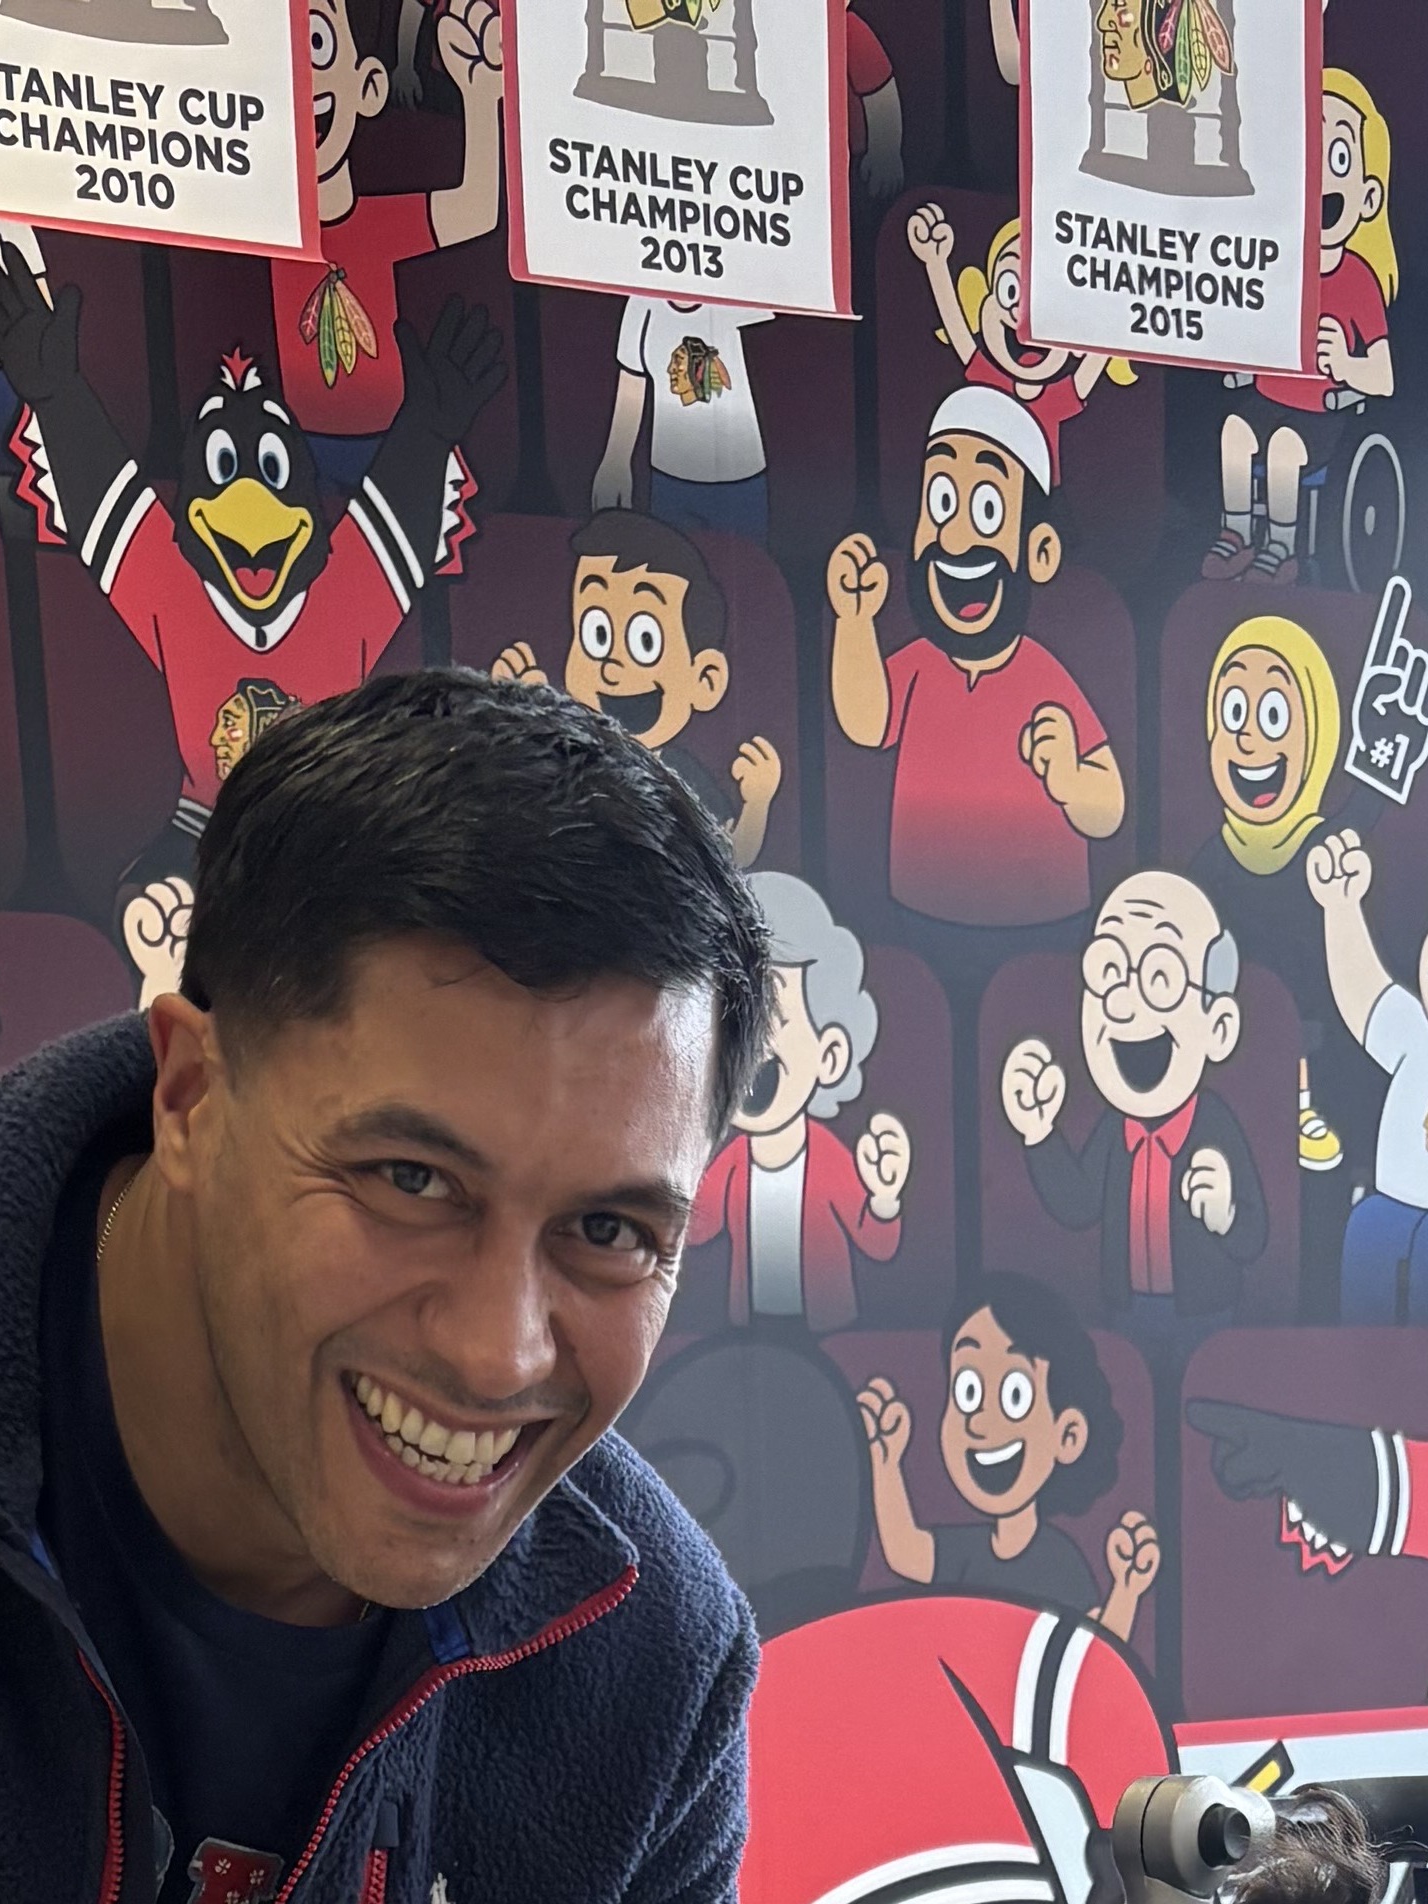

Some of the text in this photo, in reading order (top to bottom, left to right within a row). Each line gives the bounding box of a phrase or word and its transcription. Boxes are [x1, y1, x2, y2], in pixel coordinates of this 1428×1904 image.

[178, 89, 265, 131] CUP
[76, 164, 175, 210] 2010
[548, 138, 804, 205] STANLEY CUP
[565, 184, 791, 247] CHAMPIONS
[640, 236, 724, 279] 2013
[1055, 210, 1280, 271] STANLEY CUP
[1066, 254, 1265, 311] CHAMPIONS
[1130, 302, 1203, 341] 2015
[1370, 732, 1409, 781] #1
